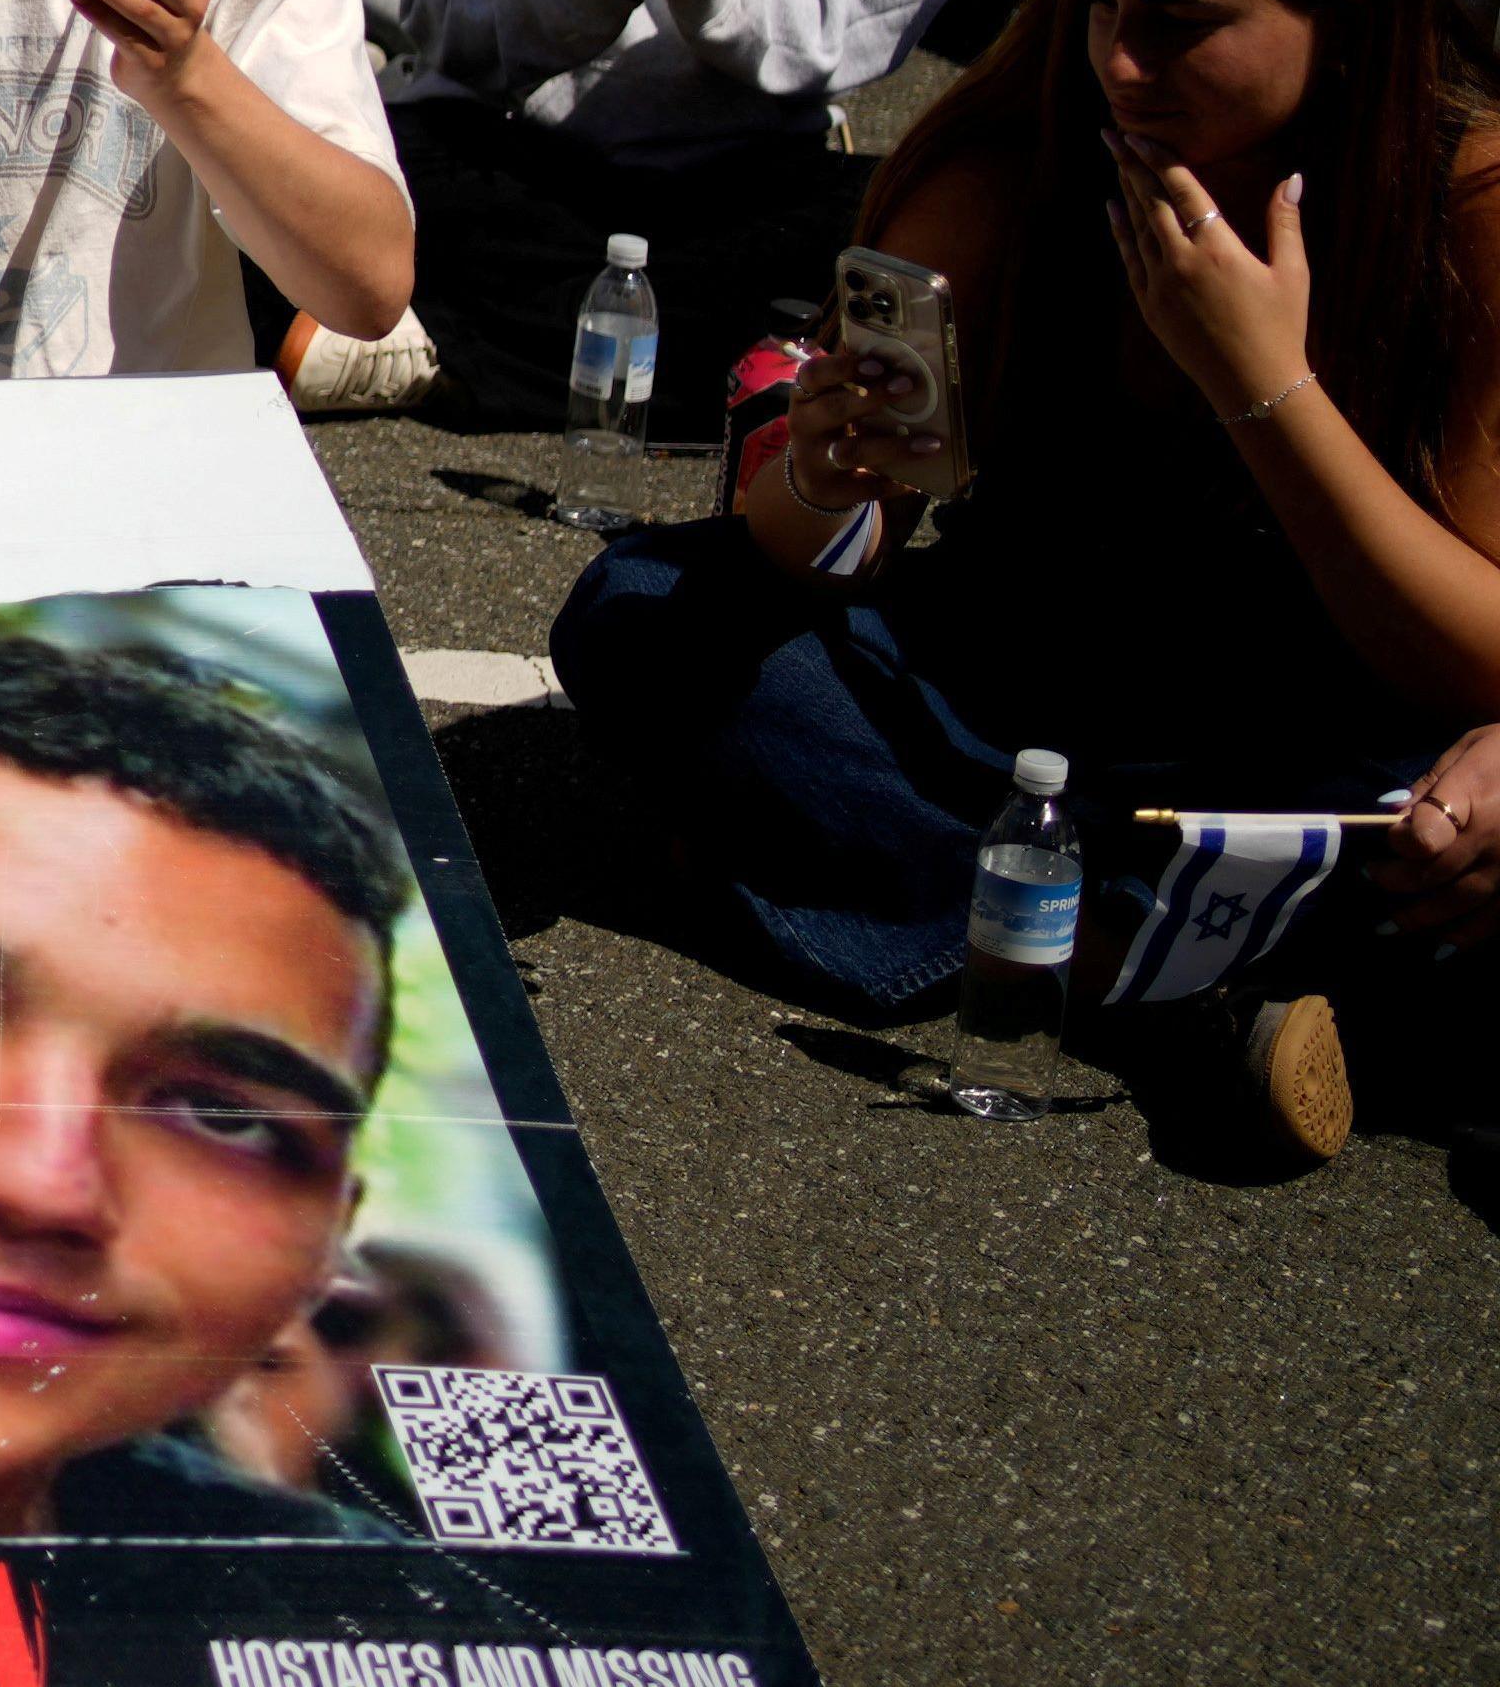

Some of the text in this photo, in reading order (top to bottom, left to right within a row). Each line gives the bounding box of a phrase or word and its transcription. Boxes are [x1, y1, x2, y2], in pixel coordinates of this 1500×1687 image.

[1039, 894, 1080, 913] SPRIN
[209, 1639, 754, 1687] HOSTAGES AND MISSING
